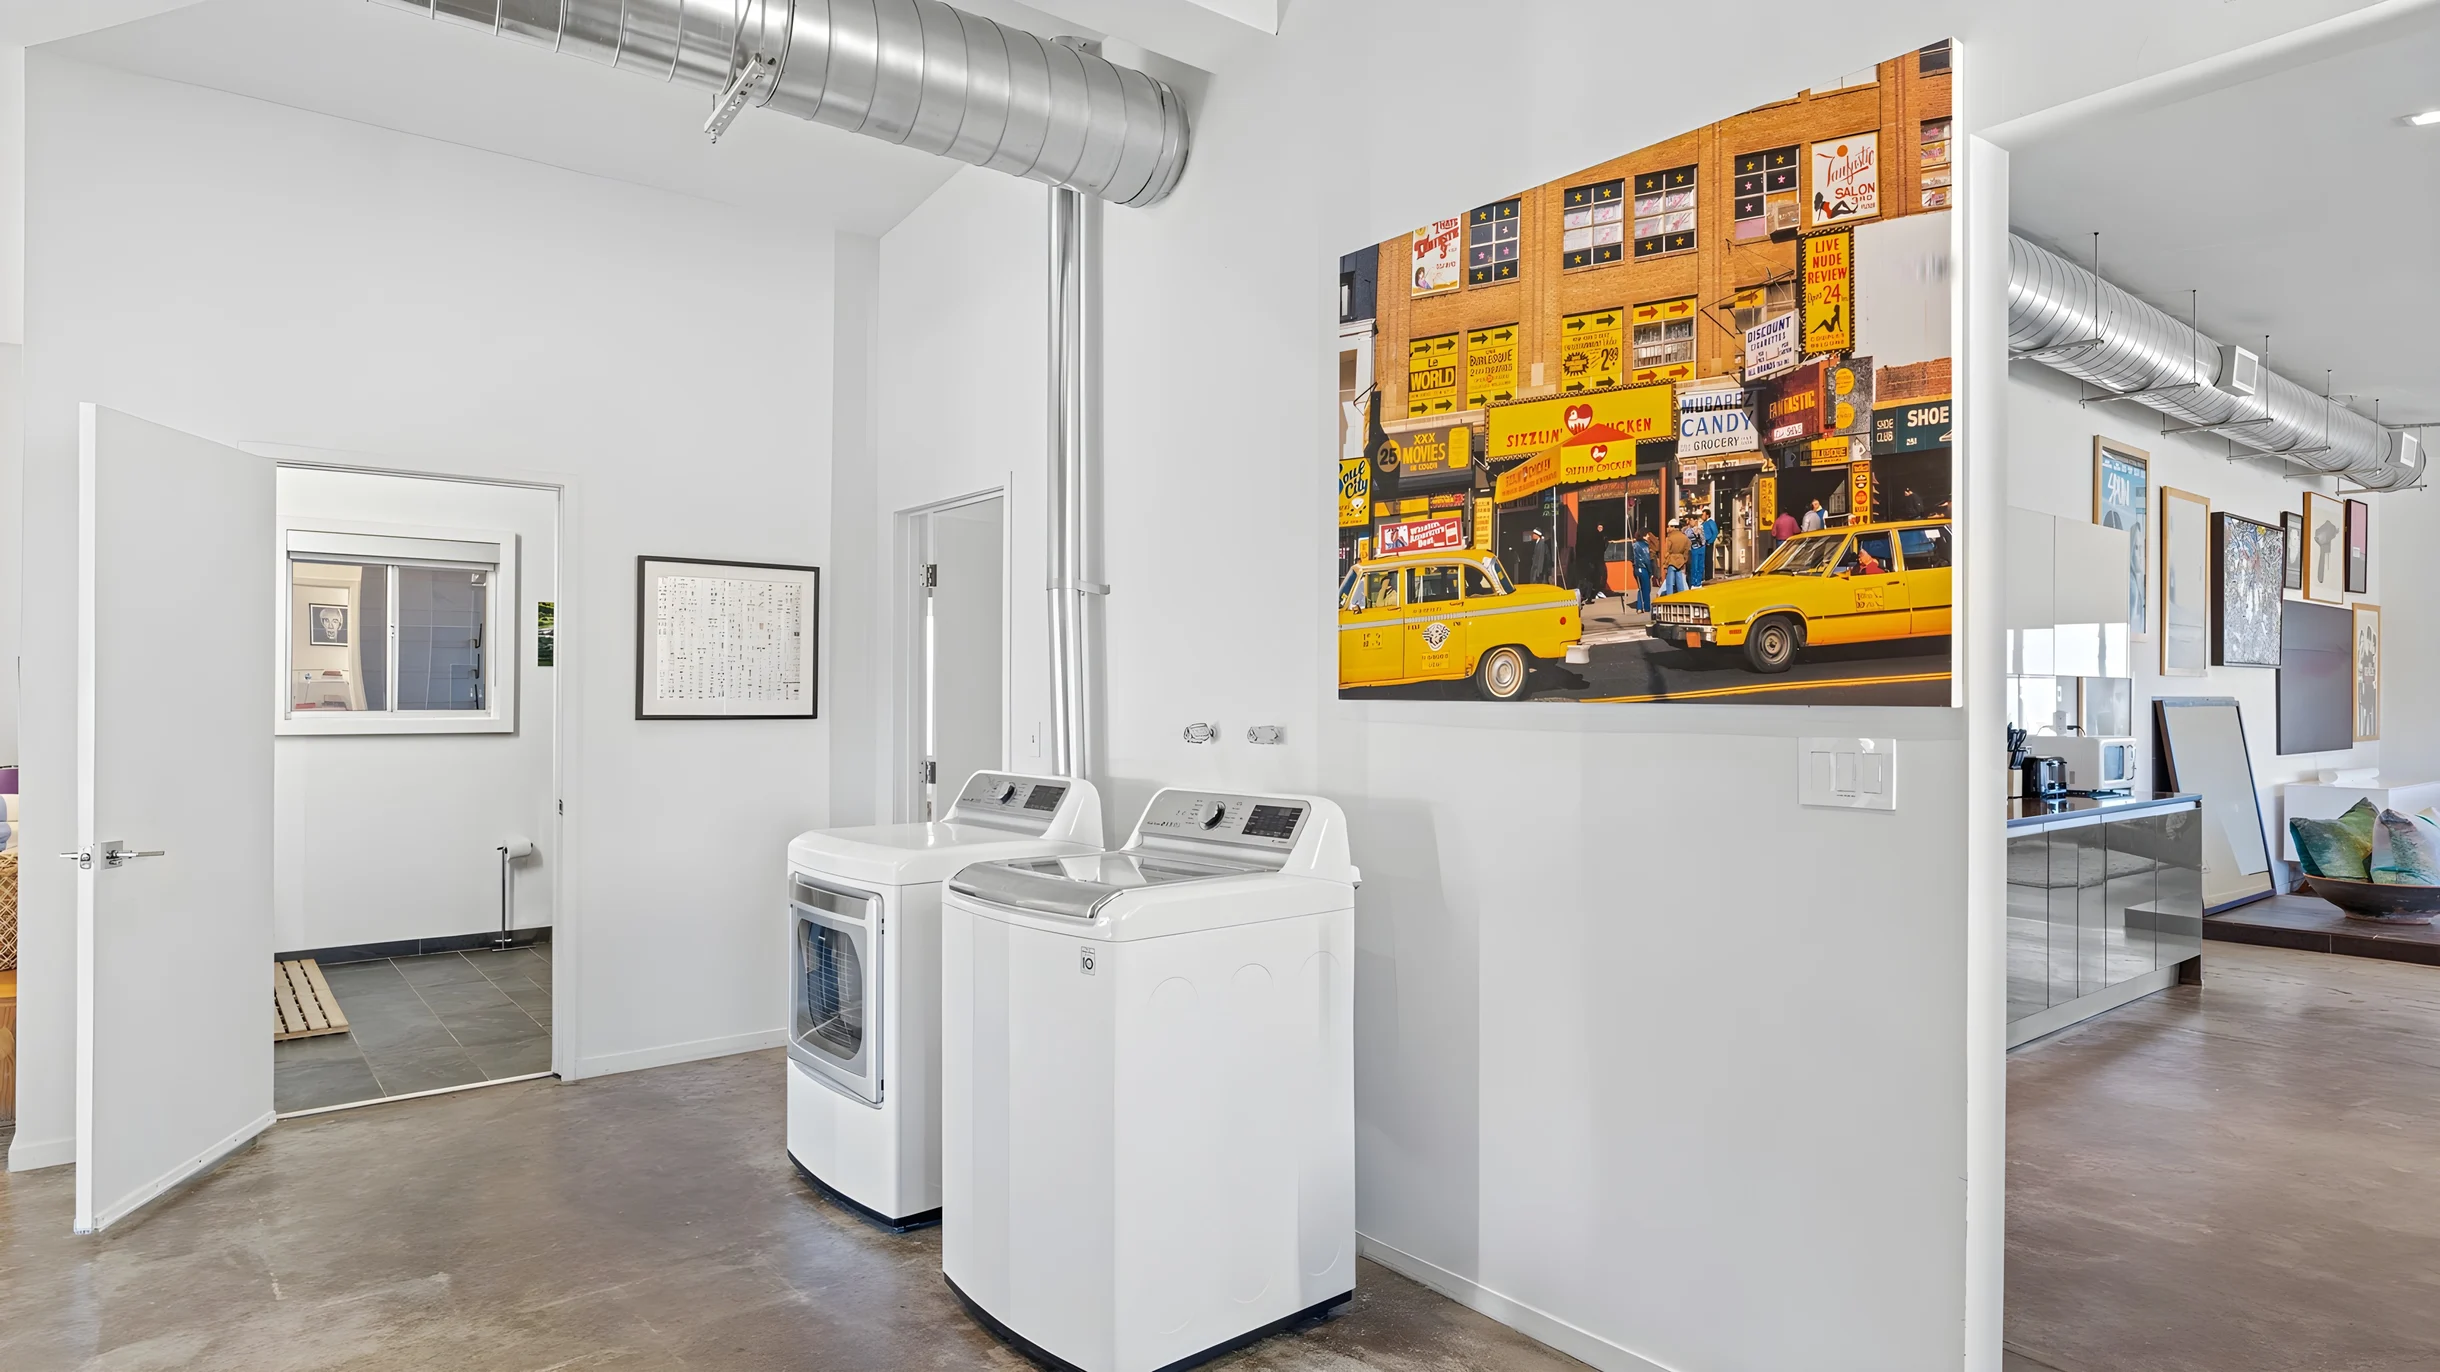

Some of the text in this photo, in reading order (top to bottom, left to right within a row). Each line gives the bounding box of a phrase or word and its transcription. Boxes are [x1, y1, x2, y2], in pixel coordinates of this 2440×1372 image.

[1835, 182, 1875, 200] SALON
[1815, 238, 1840, 254] LIVE
[1812, 253, 1842, 269] NUDE
[1807, 267, 1847, 285] REVIEW
[1823, 283, 1841, 305] 24
[1747, 316, 1791, 343] DISCOUNT
[1411, 367, 1455, 392] WORLD
[1769, 390, 1815, 419] FANTASTIC
[1681, 410, 1754, 437] CANDY
[1907, 405, 1950, 428] SHOE
[1413, 432, 1436, 445] XXX
[1506, 428, 1563, 448] SIZZLIN'
[1694, 436, 1740, 451] GROCERY
[1379, 447, 1397, 466] 25
[1402, 442, 1446, 465] MOVIES
[1345, 477, 1369, 499] City
